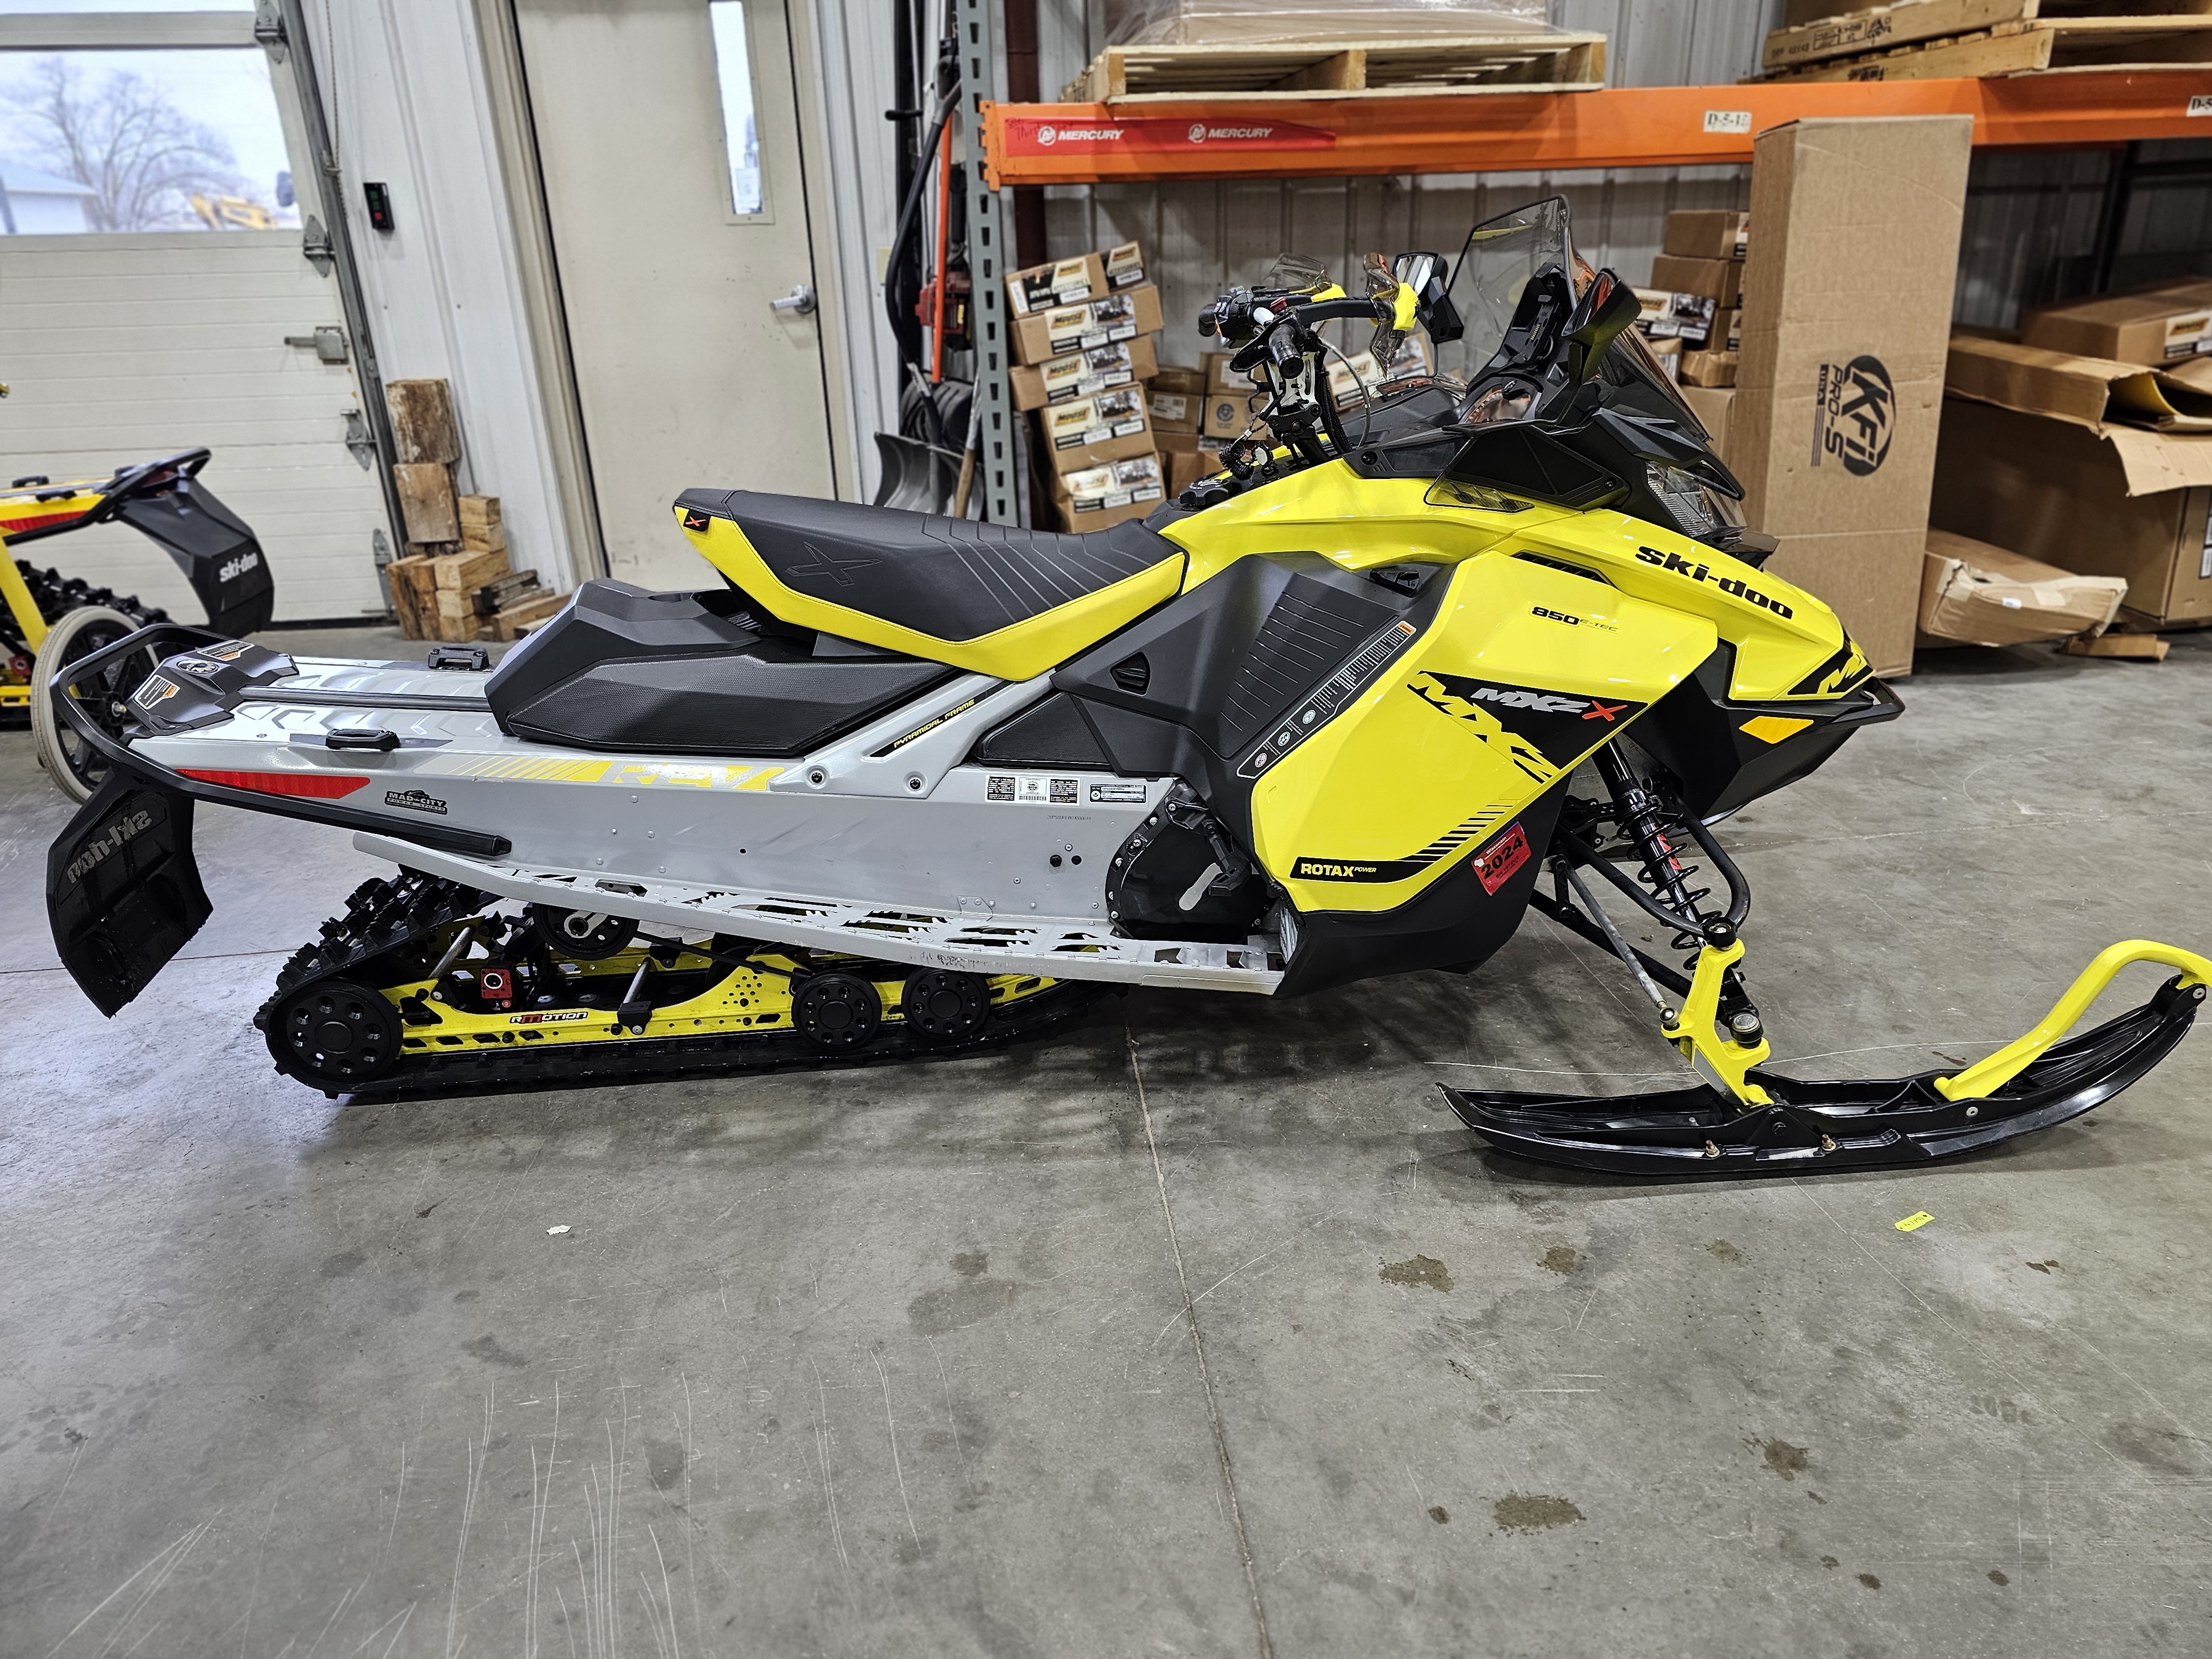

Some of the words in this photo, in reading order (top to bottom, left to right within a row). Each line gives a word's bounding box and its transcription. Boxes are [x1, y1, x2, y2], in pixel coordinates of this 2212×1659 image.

[1057, 129, 1124, 141] MERCURY
[1208, 128, 1272, 139] MERCURY
[1055, 312, 1082, 324] MOOSE
[1050, 362, 1077, 374] MOOSE
[1057, 409, 1087, 421] MOOSE
[1825, 364, 1844, 458] PRO-S
[1532, 606, 1580, 625] 850
[1470, 687, 1591, 713] MXZ
[894, 718, 943, 748] PYRAMIDAL
[945, 698, 975, 720] FRAME
[389, 792, 414, 802] MAD
[420, 797, 444, 806] CITY
[1485, 836, 1507, 854] Wisconsin
[1481, 836, 1524, 880] 2024
[1301, 863, 1355, 877] ROTAX
